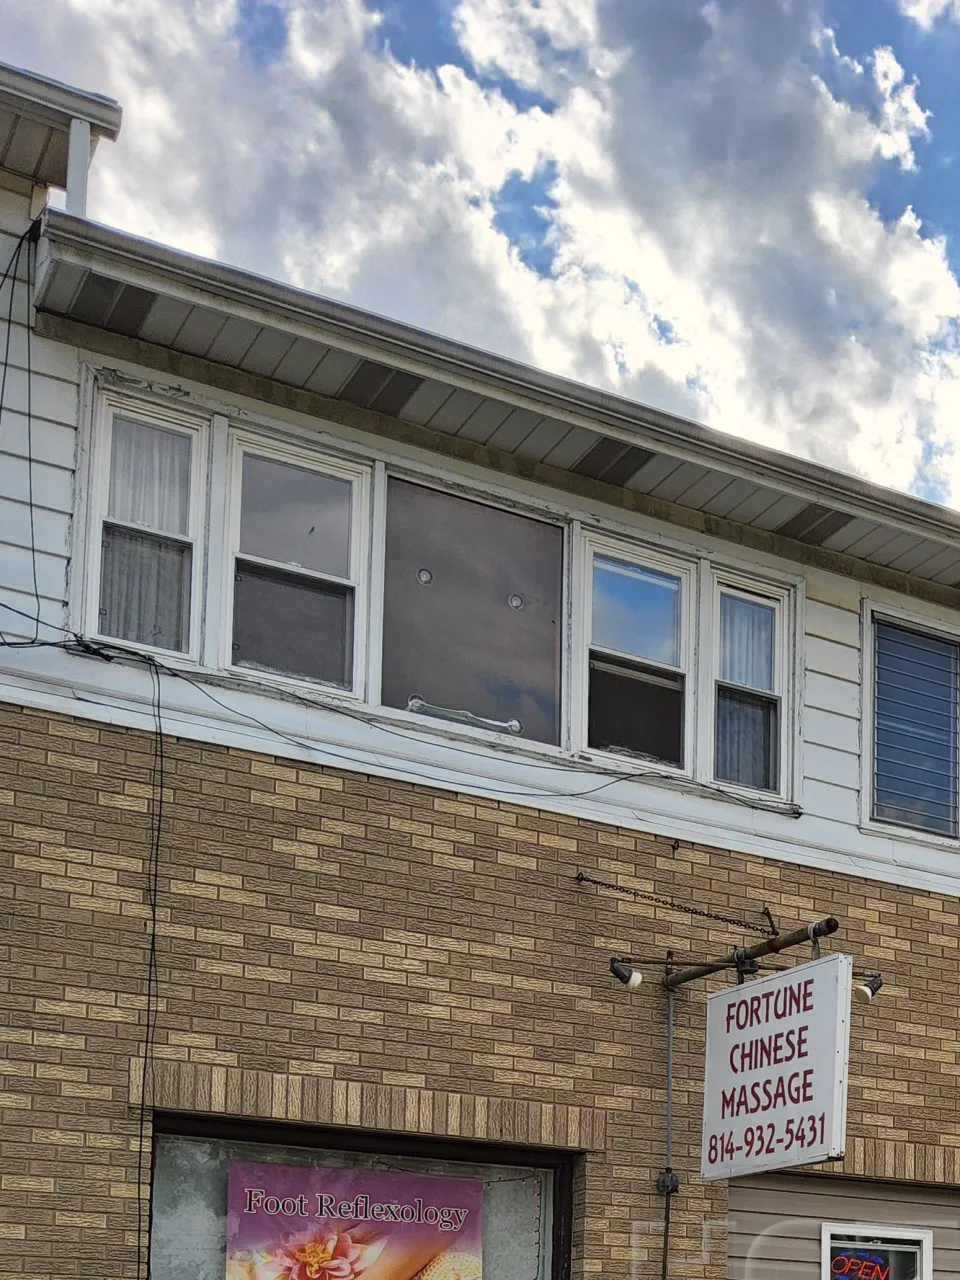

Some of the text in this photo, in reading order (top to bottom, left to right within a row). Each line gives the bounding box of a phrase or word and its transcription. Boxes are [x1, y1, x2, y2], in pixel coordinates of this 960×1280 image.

[726, 979, 815, 1034] FORTUNE
[729, 1025, 809, 1075] CHINESE
[721, 1069, 815, 1120] MASSAGE
[707, 1112, 826, 1165] 814-932-5431
[245, 1189, 469, 1230] Foot Reflexology
[831, 1256, 890, 1280] OPEN
